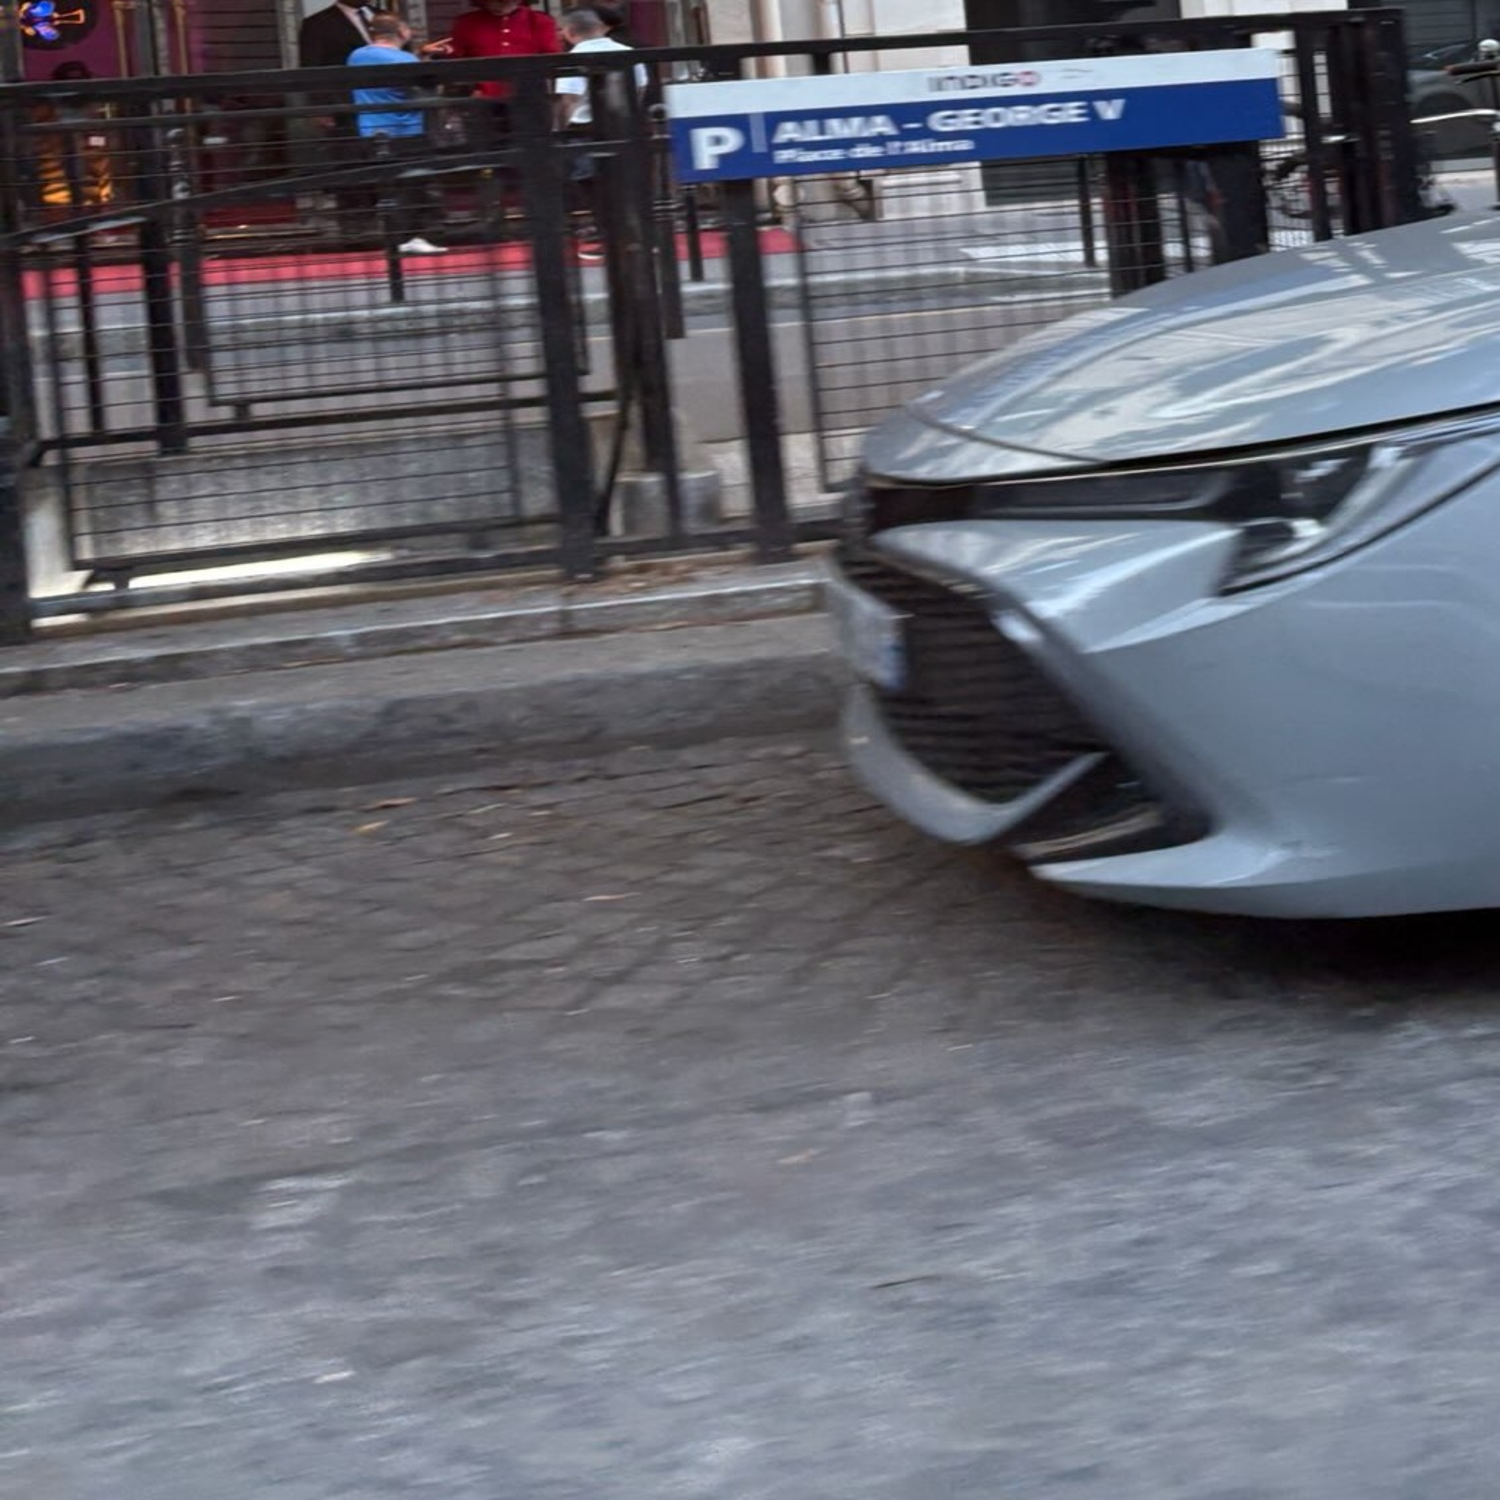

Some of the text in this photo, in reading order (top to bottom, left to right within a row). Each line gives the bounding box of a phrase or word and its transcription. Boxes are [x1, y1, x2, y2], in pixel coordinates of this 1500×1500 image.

[771, 114, 901, 144] ALMA
[926, 101, 1091, 132] GEORGE
[1092, 98, 1126, 120] V
[689, 126, 746, 171] P
